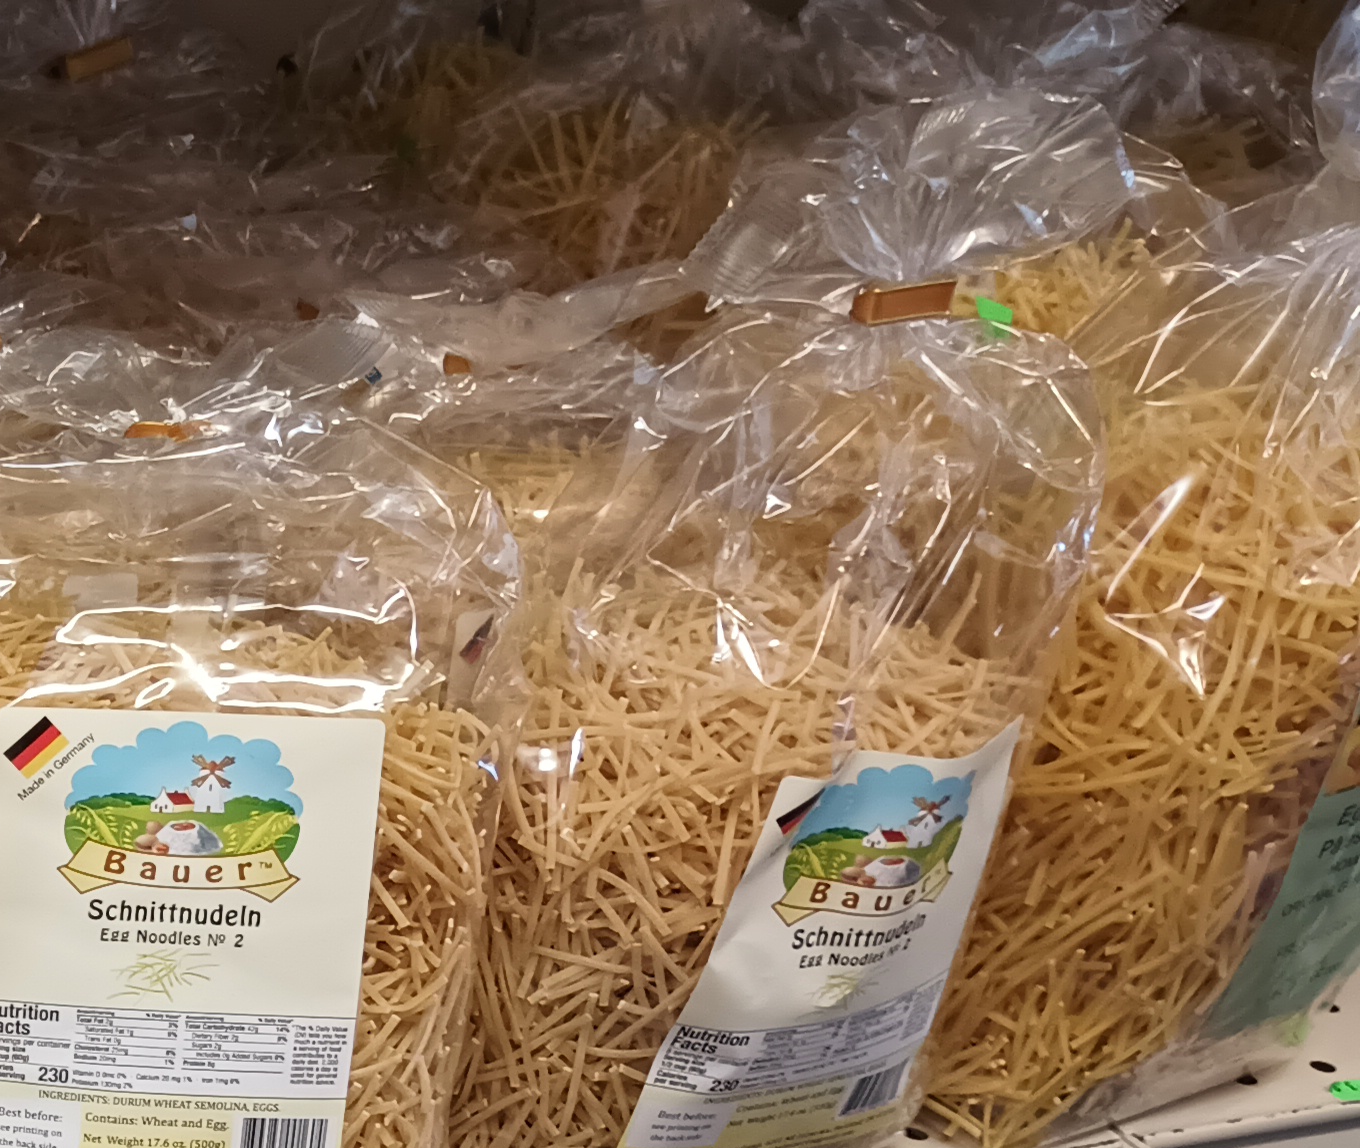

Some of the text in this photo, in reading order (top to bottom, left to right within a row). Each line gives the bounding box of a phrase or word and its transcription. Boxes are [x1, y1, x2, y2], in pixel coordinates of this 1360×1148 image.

[17, 732, 96, 802] Made in Germany
[103, 849, 253, 884] Bauer
[809, 875, 931, 911] Bauer
[88, 899, 262, 928] Schnittnudeln
[100, 928, 130, 943] Egg
[136, 929, 201, 947] Noodles
[233, 933, 244, 948] 2
[792, 914, 927, 950] Schnittnudeln
[799, 952, 884, 969] Egg Noodles
[670, 1036, 718, 1054] Facts
[679, 1025, 750, 1048] Nutrition
[38, 1066, 69, 1084] 230
[709, 1079, 739, 1093] 230
[38, 1090, 192, 1109] INGREDIENTS: DURUM WHEAT
[24, 1108, 63, 1122] before:
[85, 1112, 138, 1126] Contains:
[141, 1115, 179, 1128] Wheat
[181, 1118, 203, 1129] and
[12, 1125, 49, 1138] printing
[83, 1133, 102, 1144] Net
[107, 1135, 144, 1147] Weight
[147, 1137, 169, 1148] 17.6
[0, 1137, 14, 1147] the
